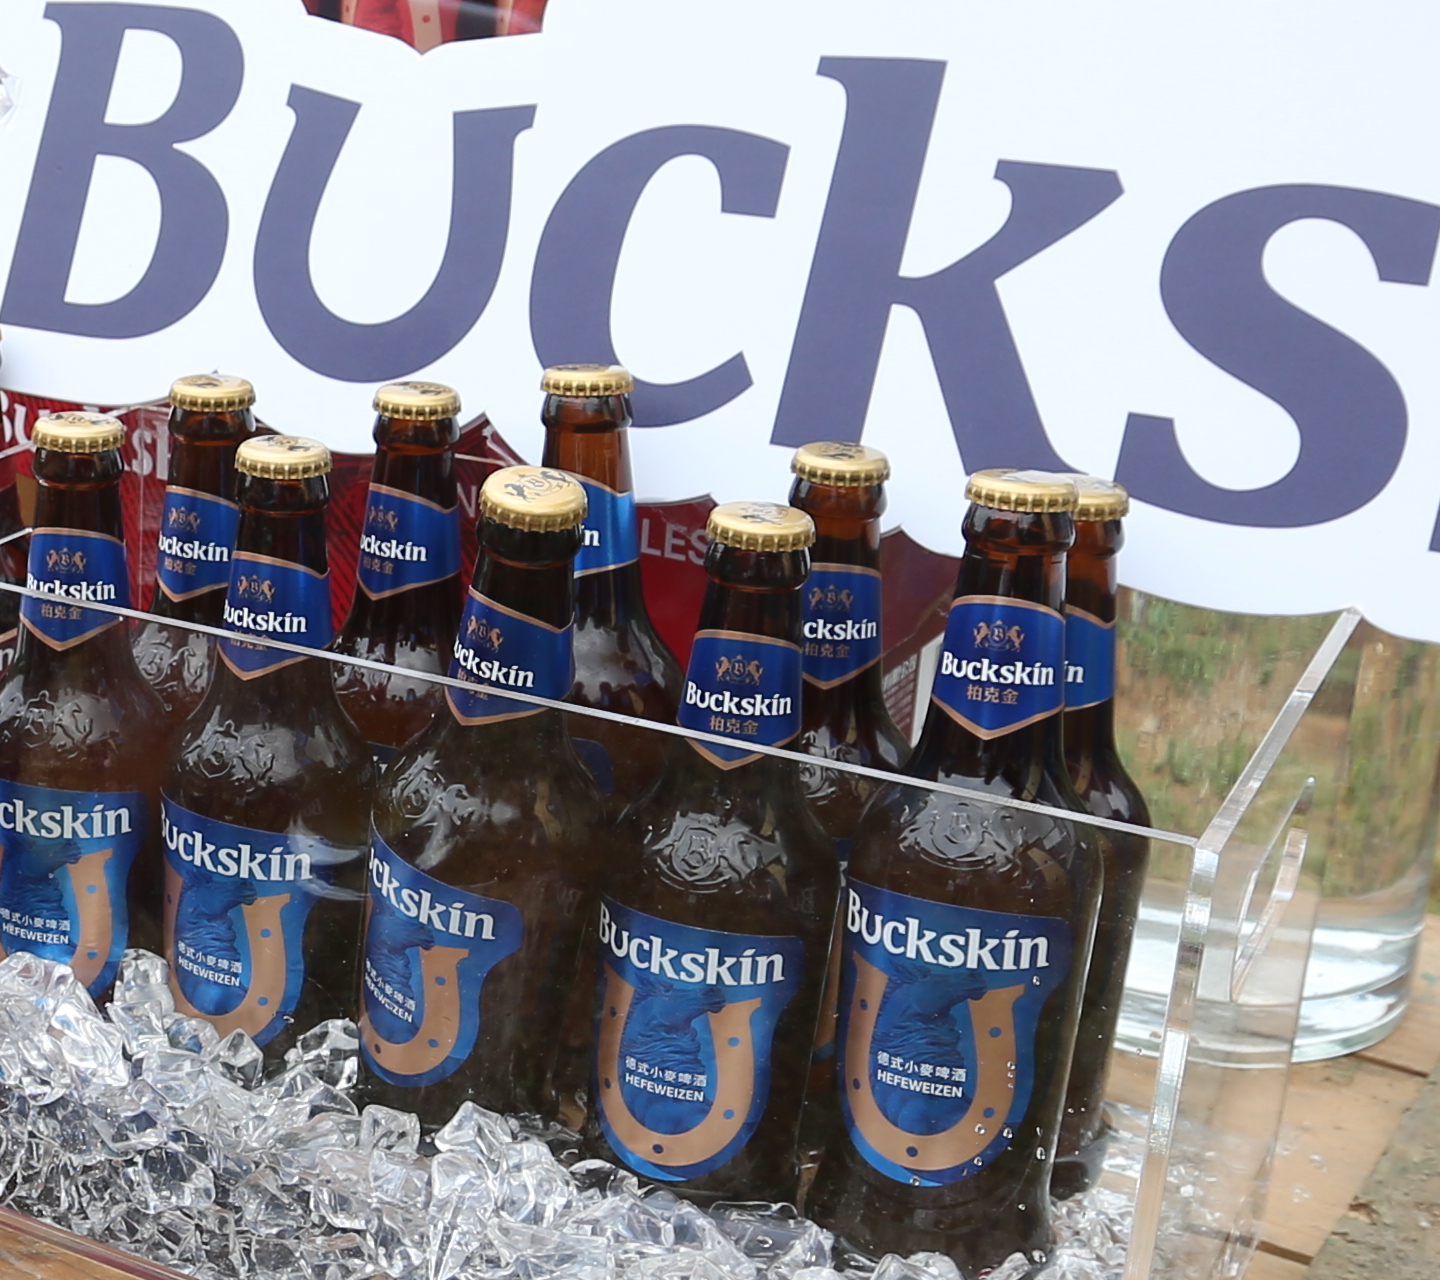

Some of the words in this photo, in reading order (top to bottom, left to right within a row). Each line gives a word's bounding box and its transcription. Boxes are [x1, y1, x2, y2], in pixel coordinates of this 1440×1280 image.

[966, 684, 1019, 706] 柏克金
[708, 715, 760, 736] 柏克金
[624, 1072, 706, 1103] HEFEWEIZEN
[876, 1068, 964, 1099] HEFEWEIZEN
